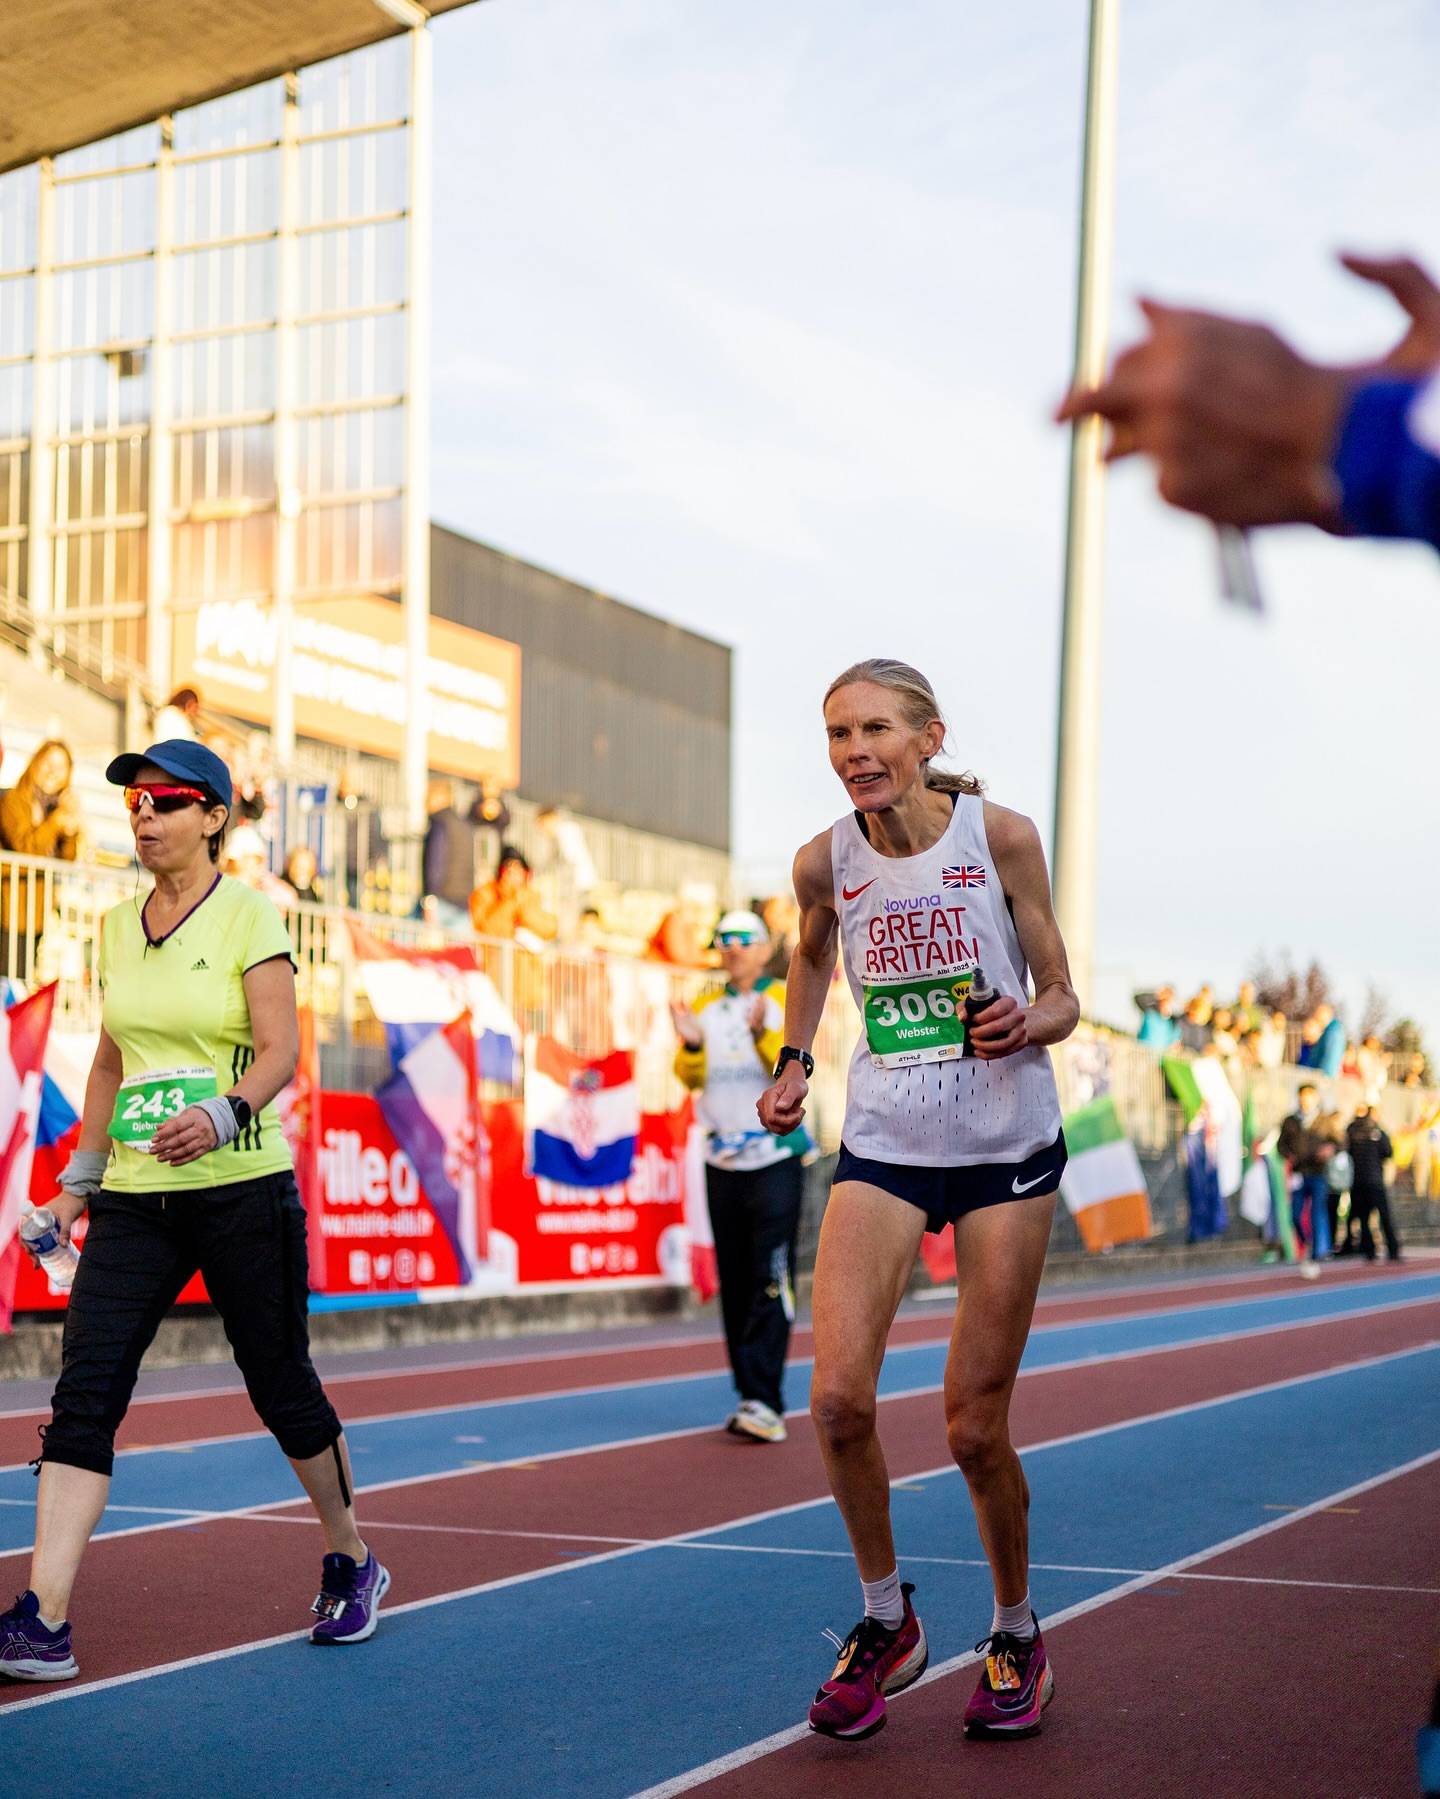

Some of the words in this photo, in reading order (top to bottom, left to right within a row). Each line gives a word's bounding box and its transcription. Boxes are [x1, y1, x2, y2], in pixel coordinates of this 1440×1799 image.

[880, 894, 941, 913] Novuna
[869, 907, 966, 946] GREAT
[866, 937, 979, 974] BRITAIN
[937, 967, 950, 975] Albi
[872, 988, 955, 1027] 306
[896, 1025, 940, 1040] Webster
[121, 1087, 186, 1120] 243
